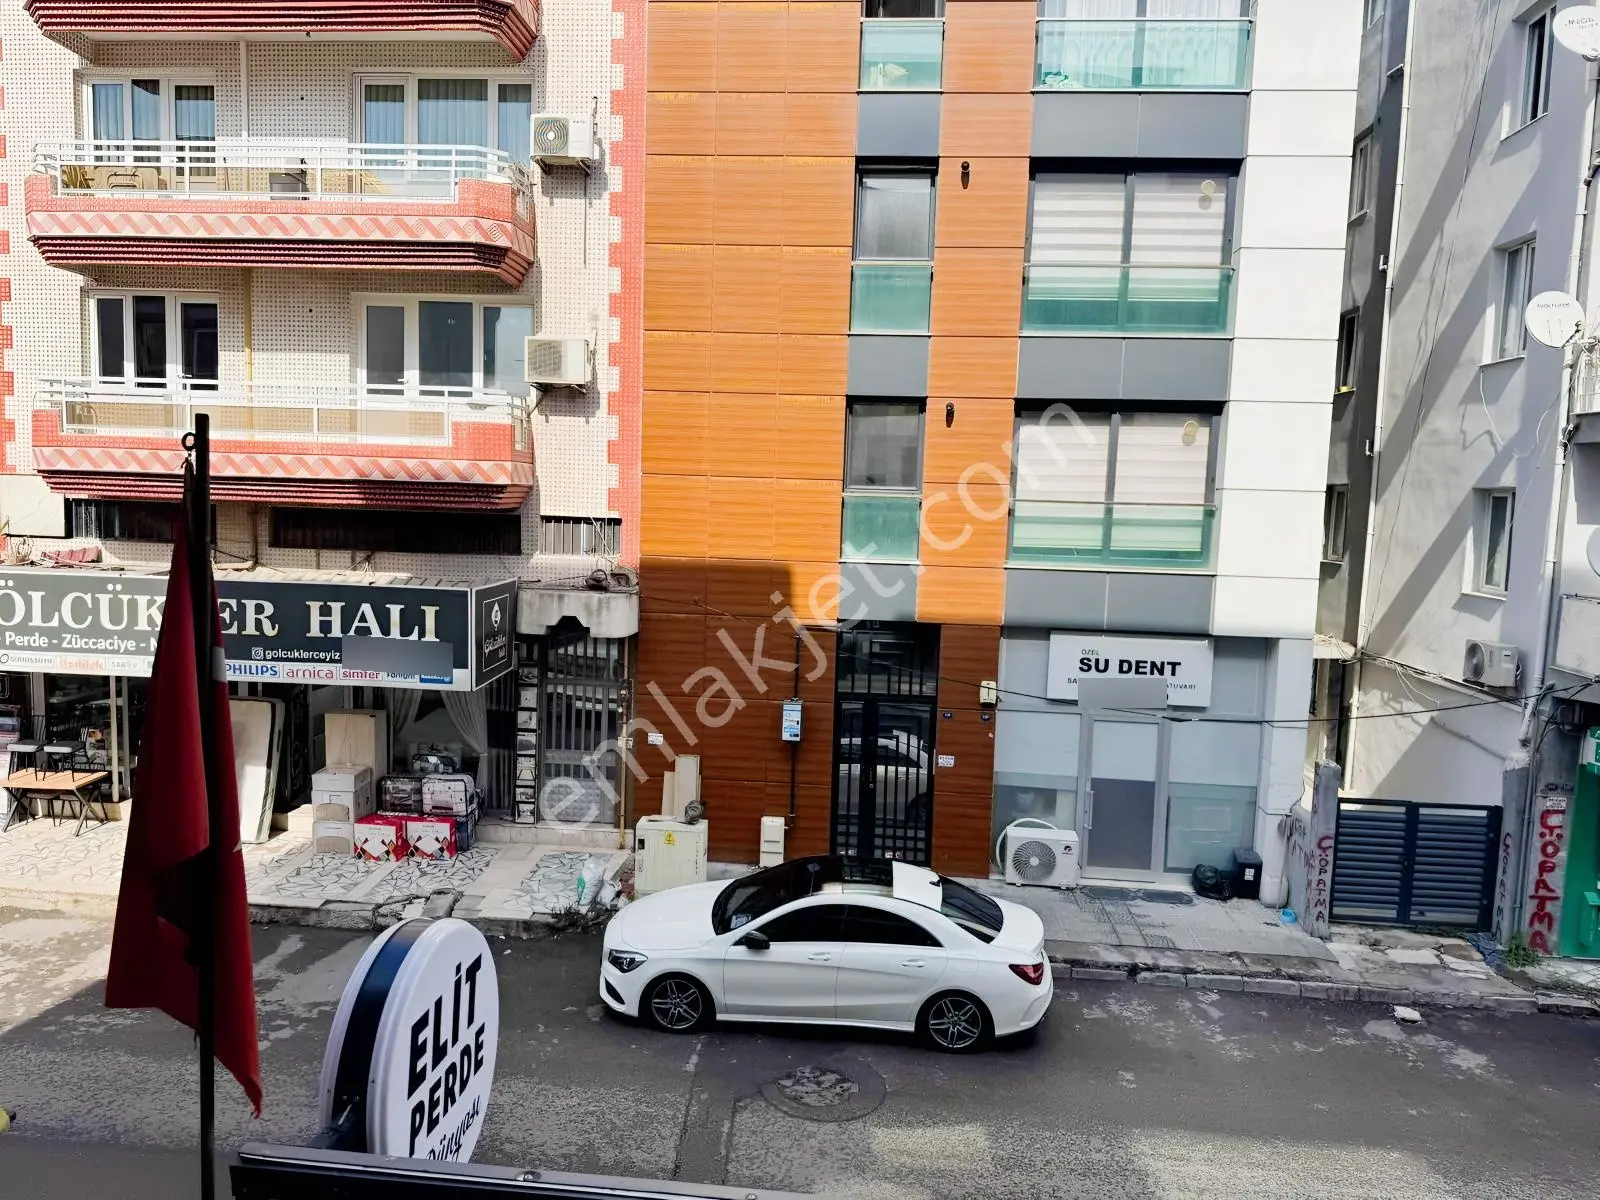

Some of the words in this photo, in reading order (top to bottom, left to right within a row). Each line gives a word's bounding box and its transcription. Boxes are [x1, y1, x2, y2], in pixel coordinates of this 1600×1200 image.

[305, 600, 440, 642] HALI
[6, 632, 48, 648] Perde
[62, 634, 136, 653] Züccaciye
[226, 664, 278, 676] PHILIPS
[286, 666, 334, 679] arnica
[1078, 657, 1110, 674] SU
[1118, 659, 1182, 677] DENT
[407, 953, 482, 1101] ELİT
[408, 1022, 486, 1159] PERDE
